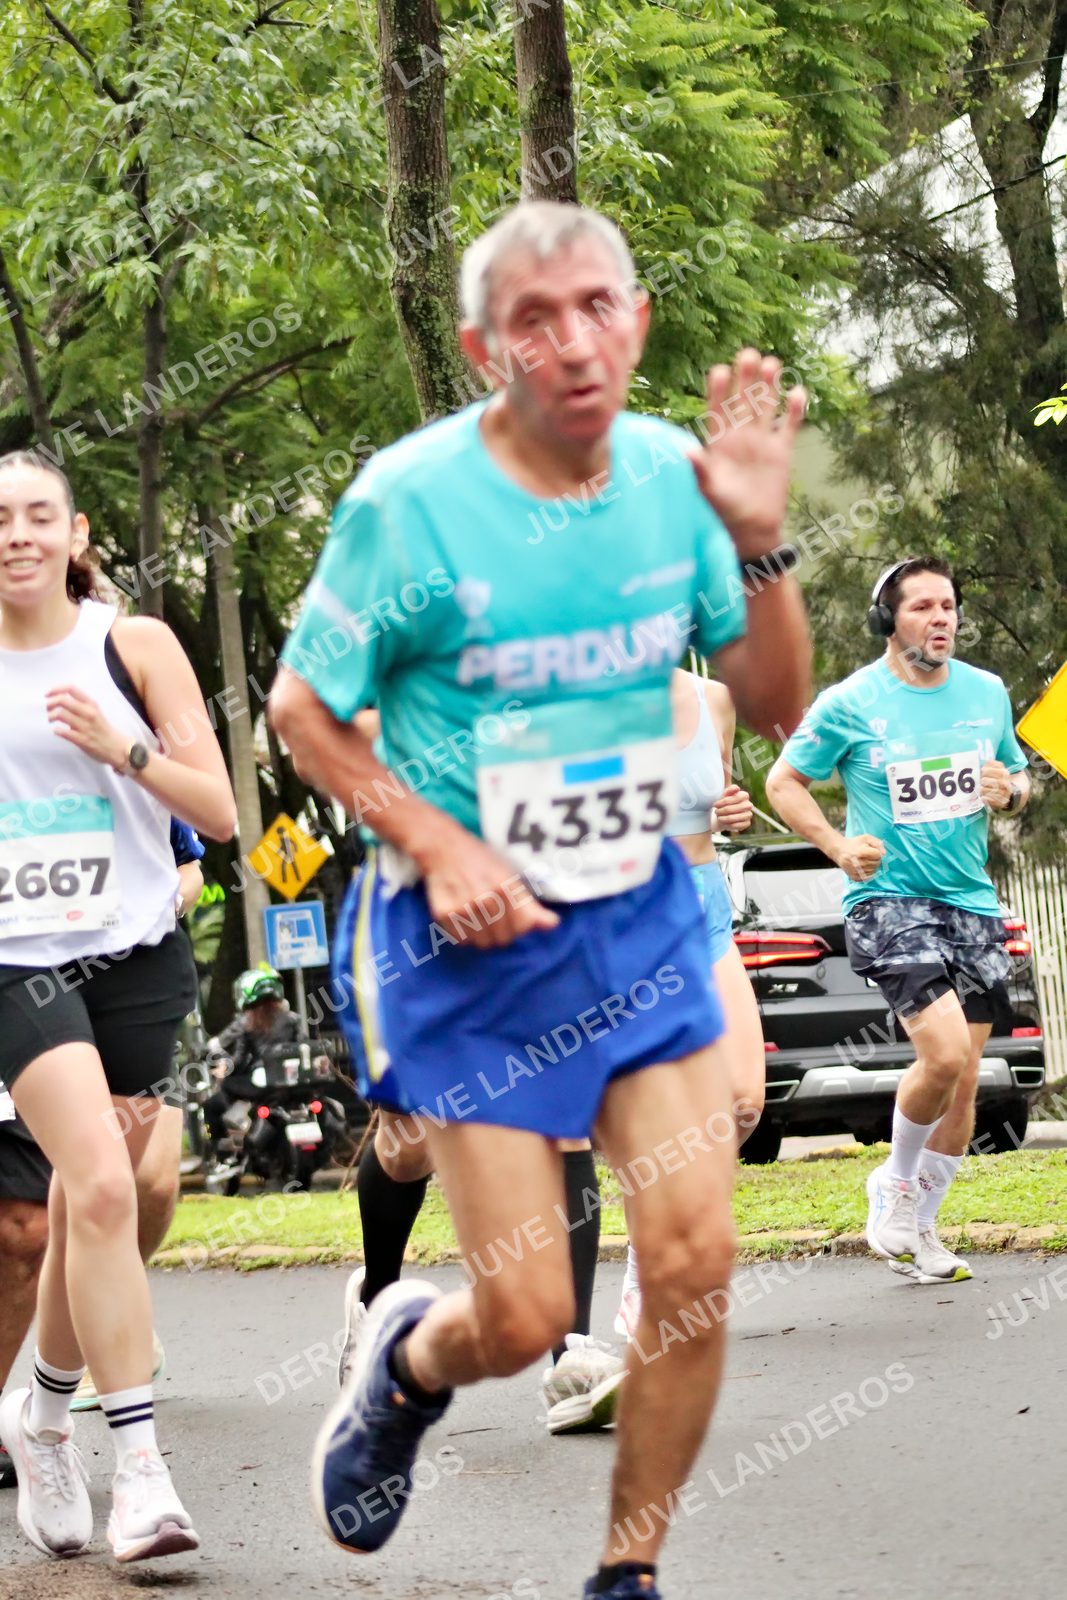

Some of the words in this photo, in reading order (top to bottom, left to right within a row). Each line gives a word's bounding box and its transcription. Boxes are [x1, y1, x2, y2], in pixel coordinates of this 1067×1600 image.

[896, 768, 975, 803] 3066
[508, 780, 668, 852] 4333
[0, 857, 110, 904] 2667
